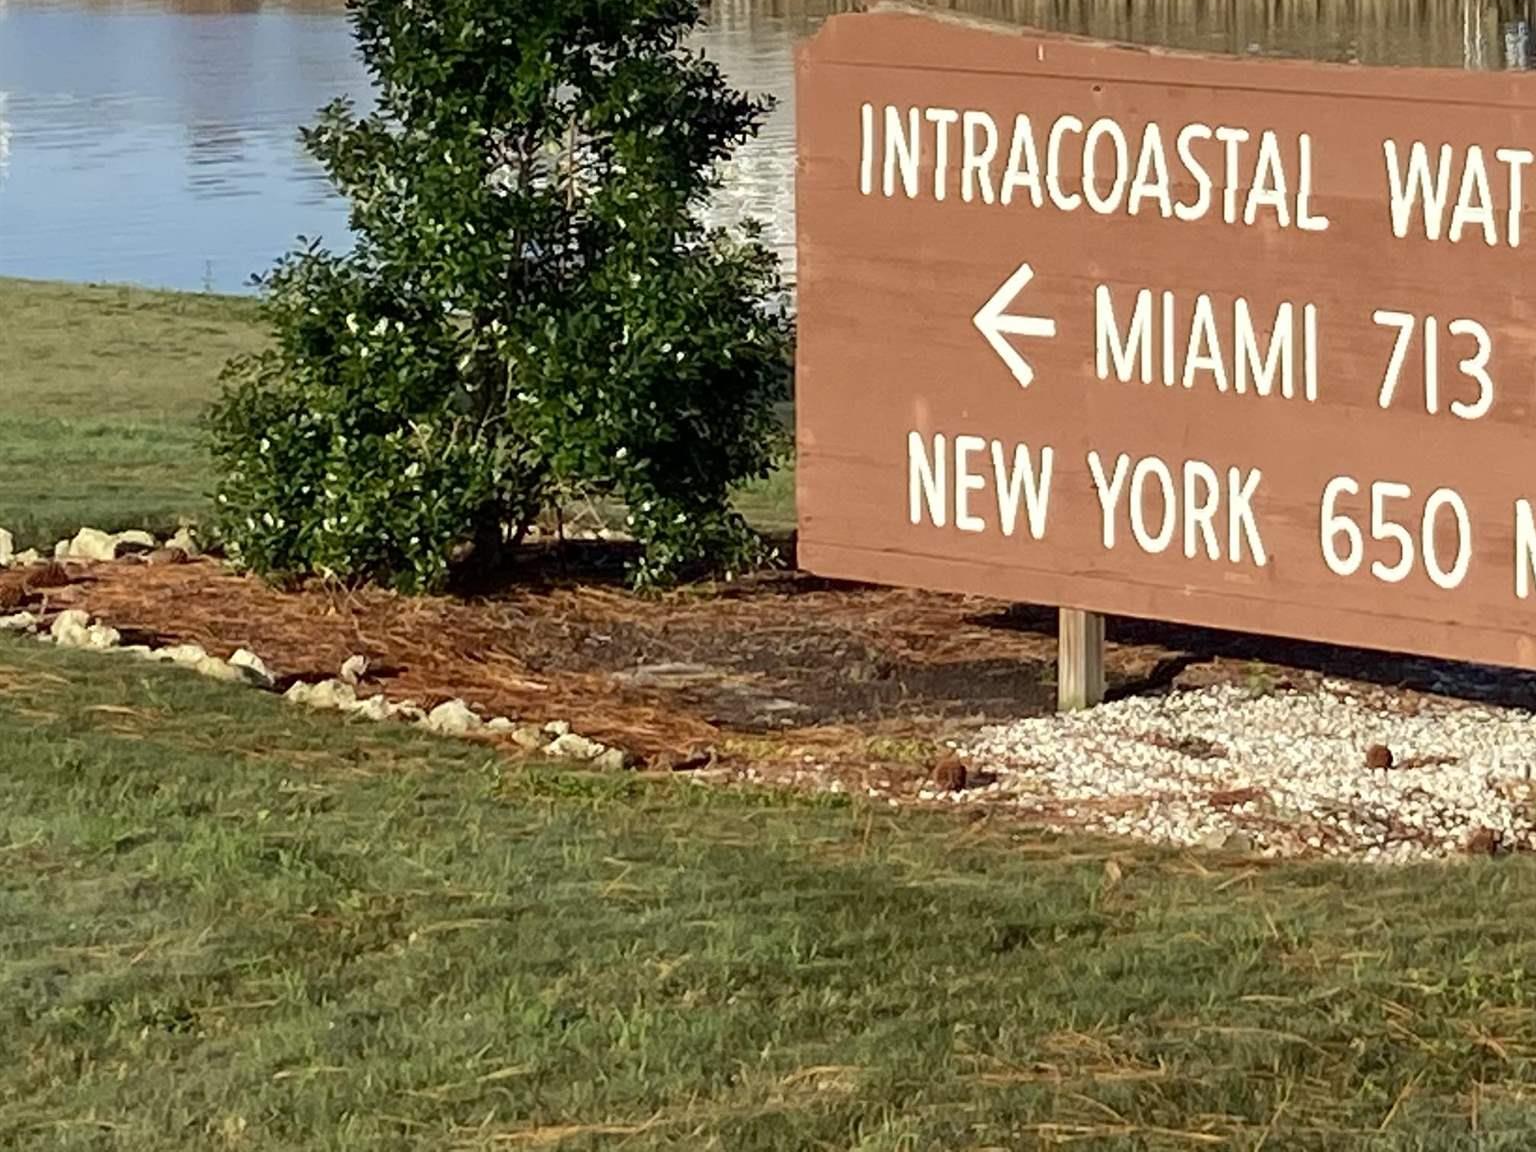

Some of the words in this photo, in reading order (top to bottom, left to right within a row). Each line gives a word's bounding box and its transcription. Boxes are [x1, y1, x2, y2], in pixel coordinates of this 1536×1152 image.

[860, 102, 1331, 232] INTRACOASTAL
[1095, 284, 1318, 403] MIAMI
[1372, 309, 1495, 421] 713
[907, 430, 1055, 540] NEW
[1086, 450, 1268, 568] YORK
[1320, 475, 1474, 590] 650
